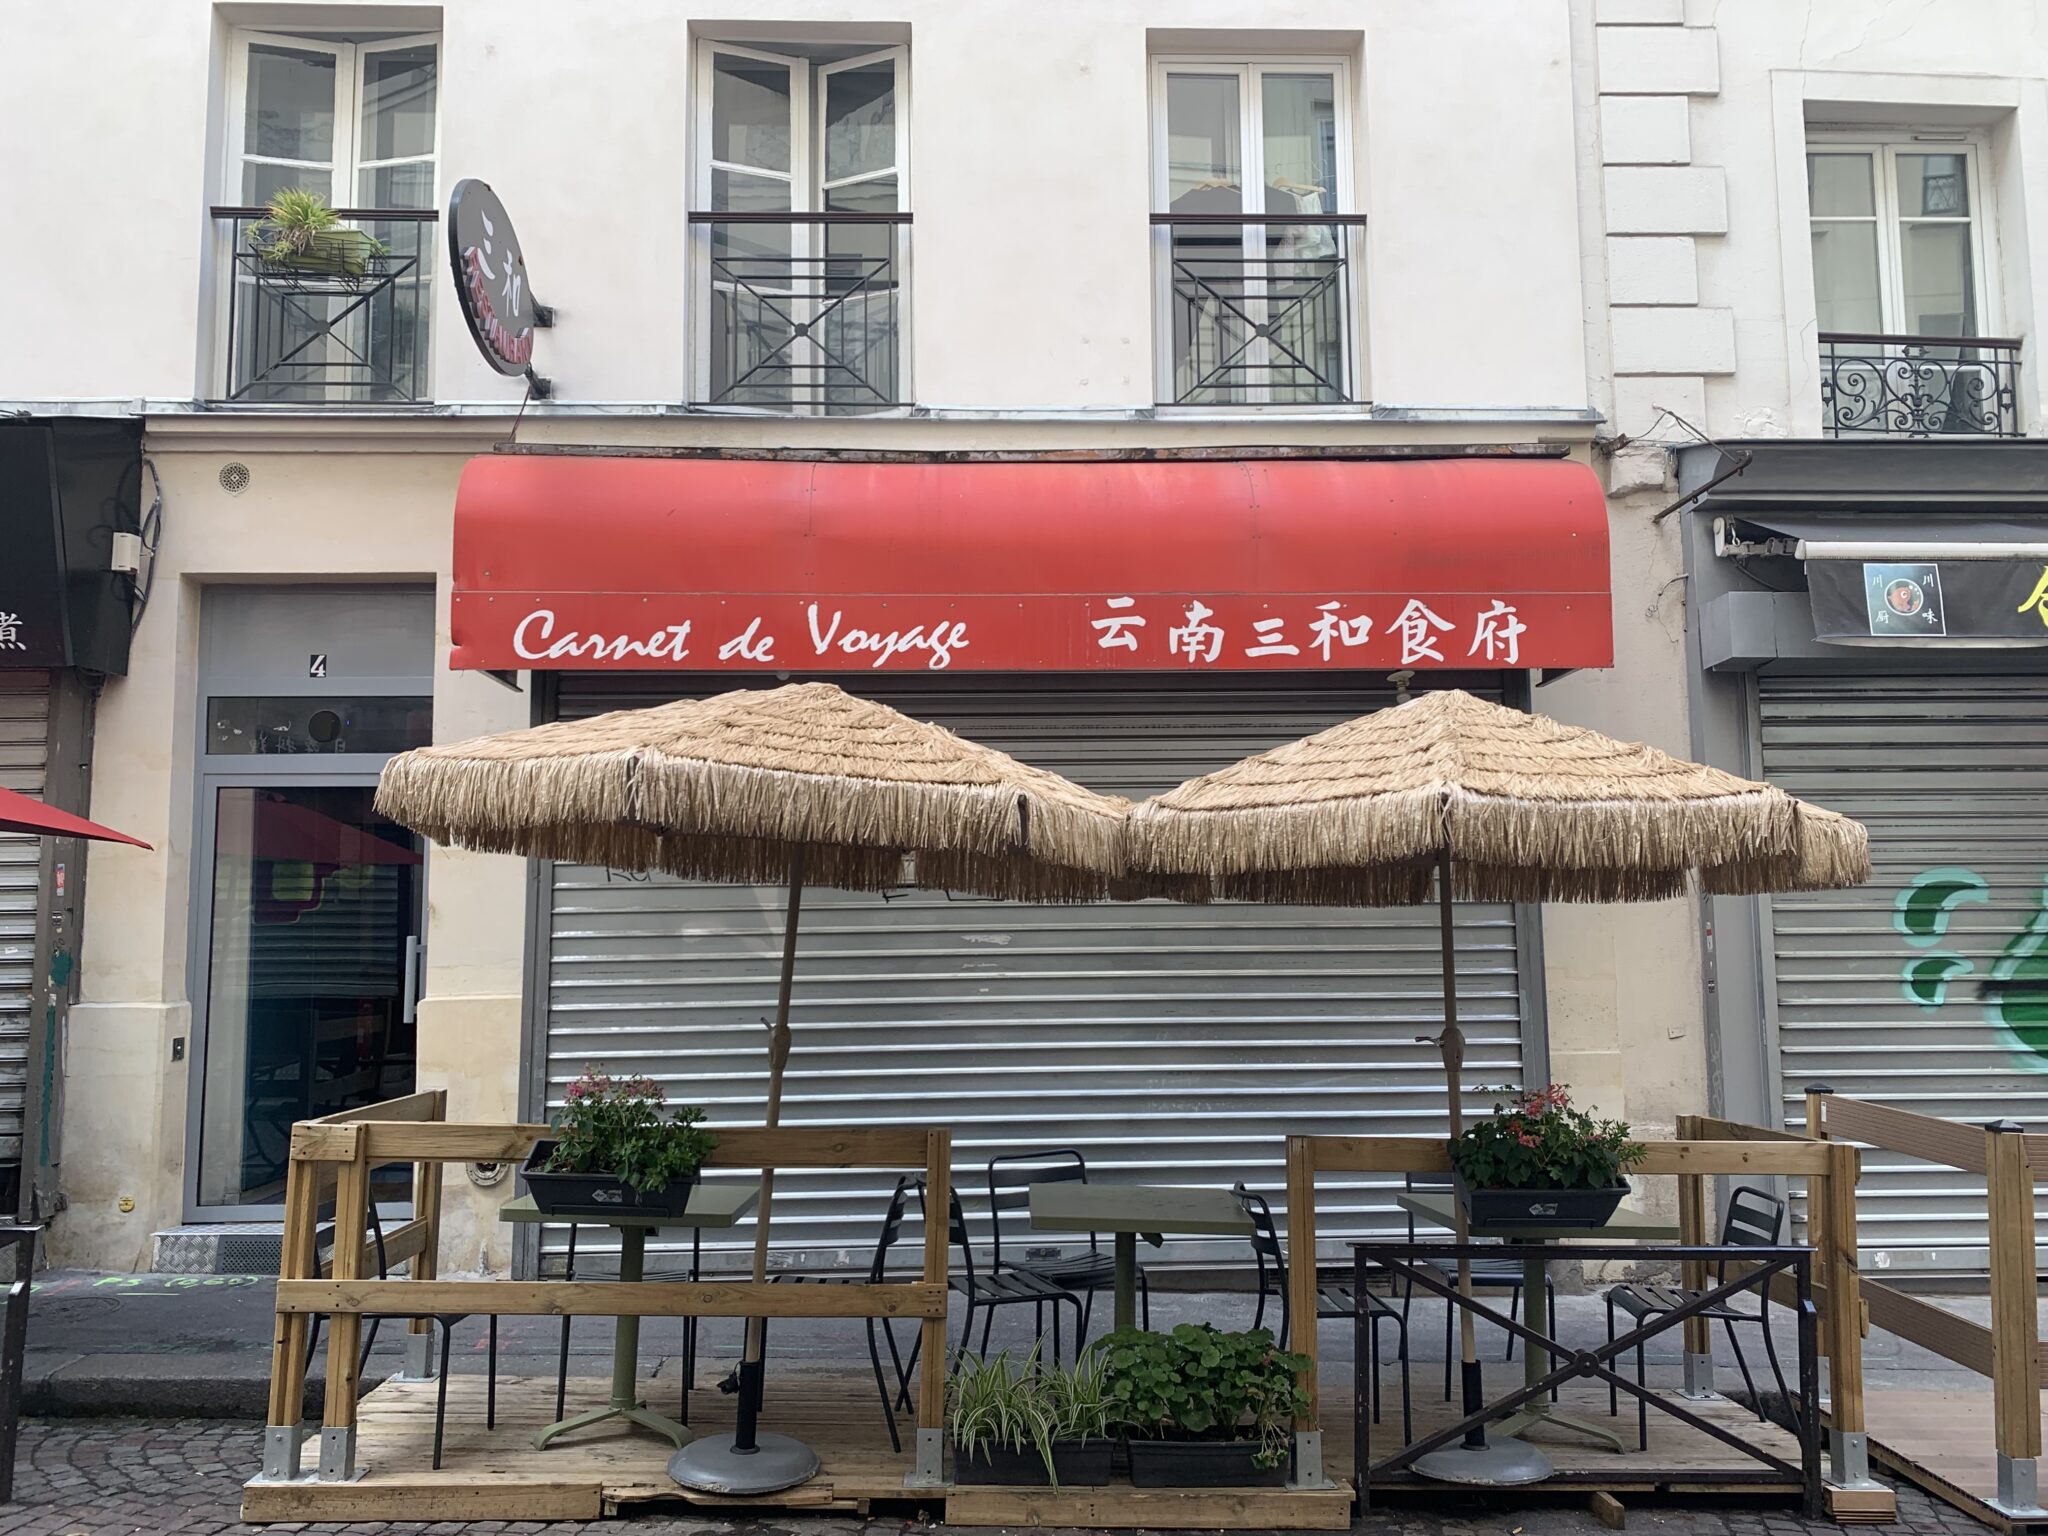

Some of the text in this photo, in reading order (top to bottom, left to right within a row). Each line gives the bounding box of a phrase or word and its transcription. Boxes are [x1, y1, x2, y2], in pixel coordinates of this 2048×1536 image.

[476, 209, 522, 318] 三和
[513, 602, 970, 670] Carnet de Voyage
[1091, 596, 1528, 665] 云南三和食府
[310, 655, 327, 677] 4
